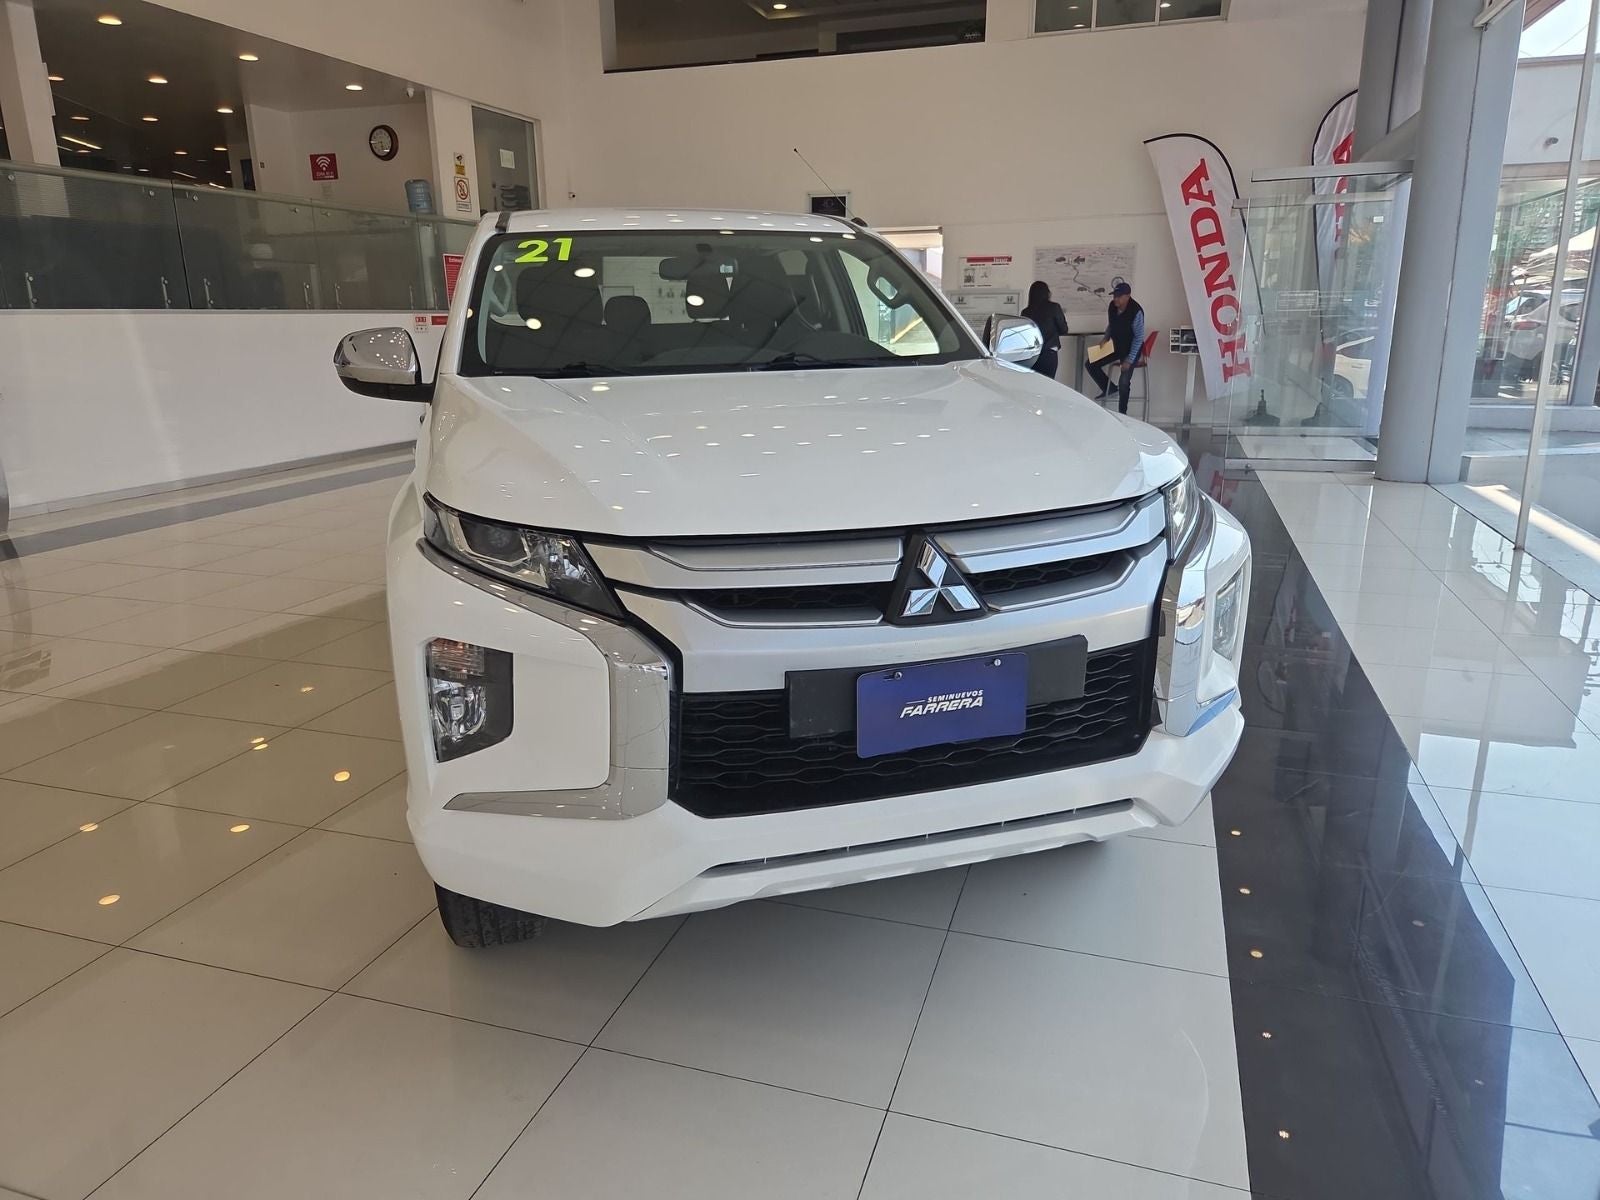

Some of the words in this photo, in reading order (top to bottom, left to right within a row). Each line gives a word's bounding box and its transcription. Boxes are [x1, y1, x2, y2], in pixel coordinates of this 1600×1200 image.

[515, 238, 573, 263] 21
[1181, 158, 1252, 383] HONDA
[900, 696, 984, 718] FARRERA
[927, 689, 984, 703] SEMINUEVOS
